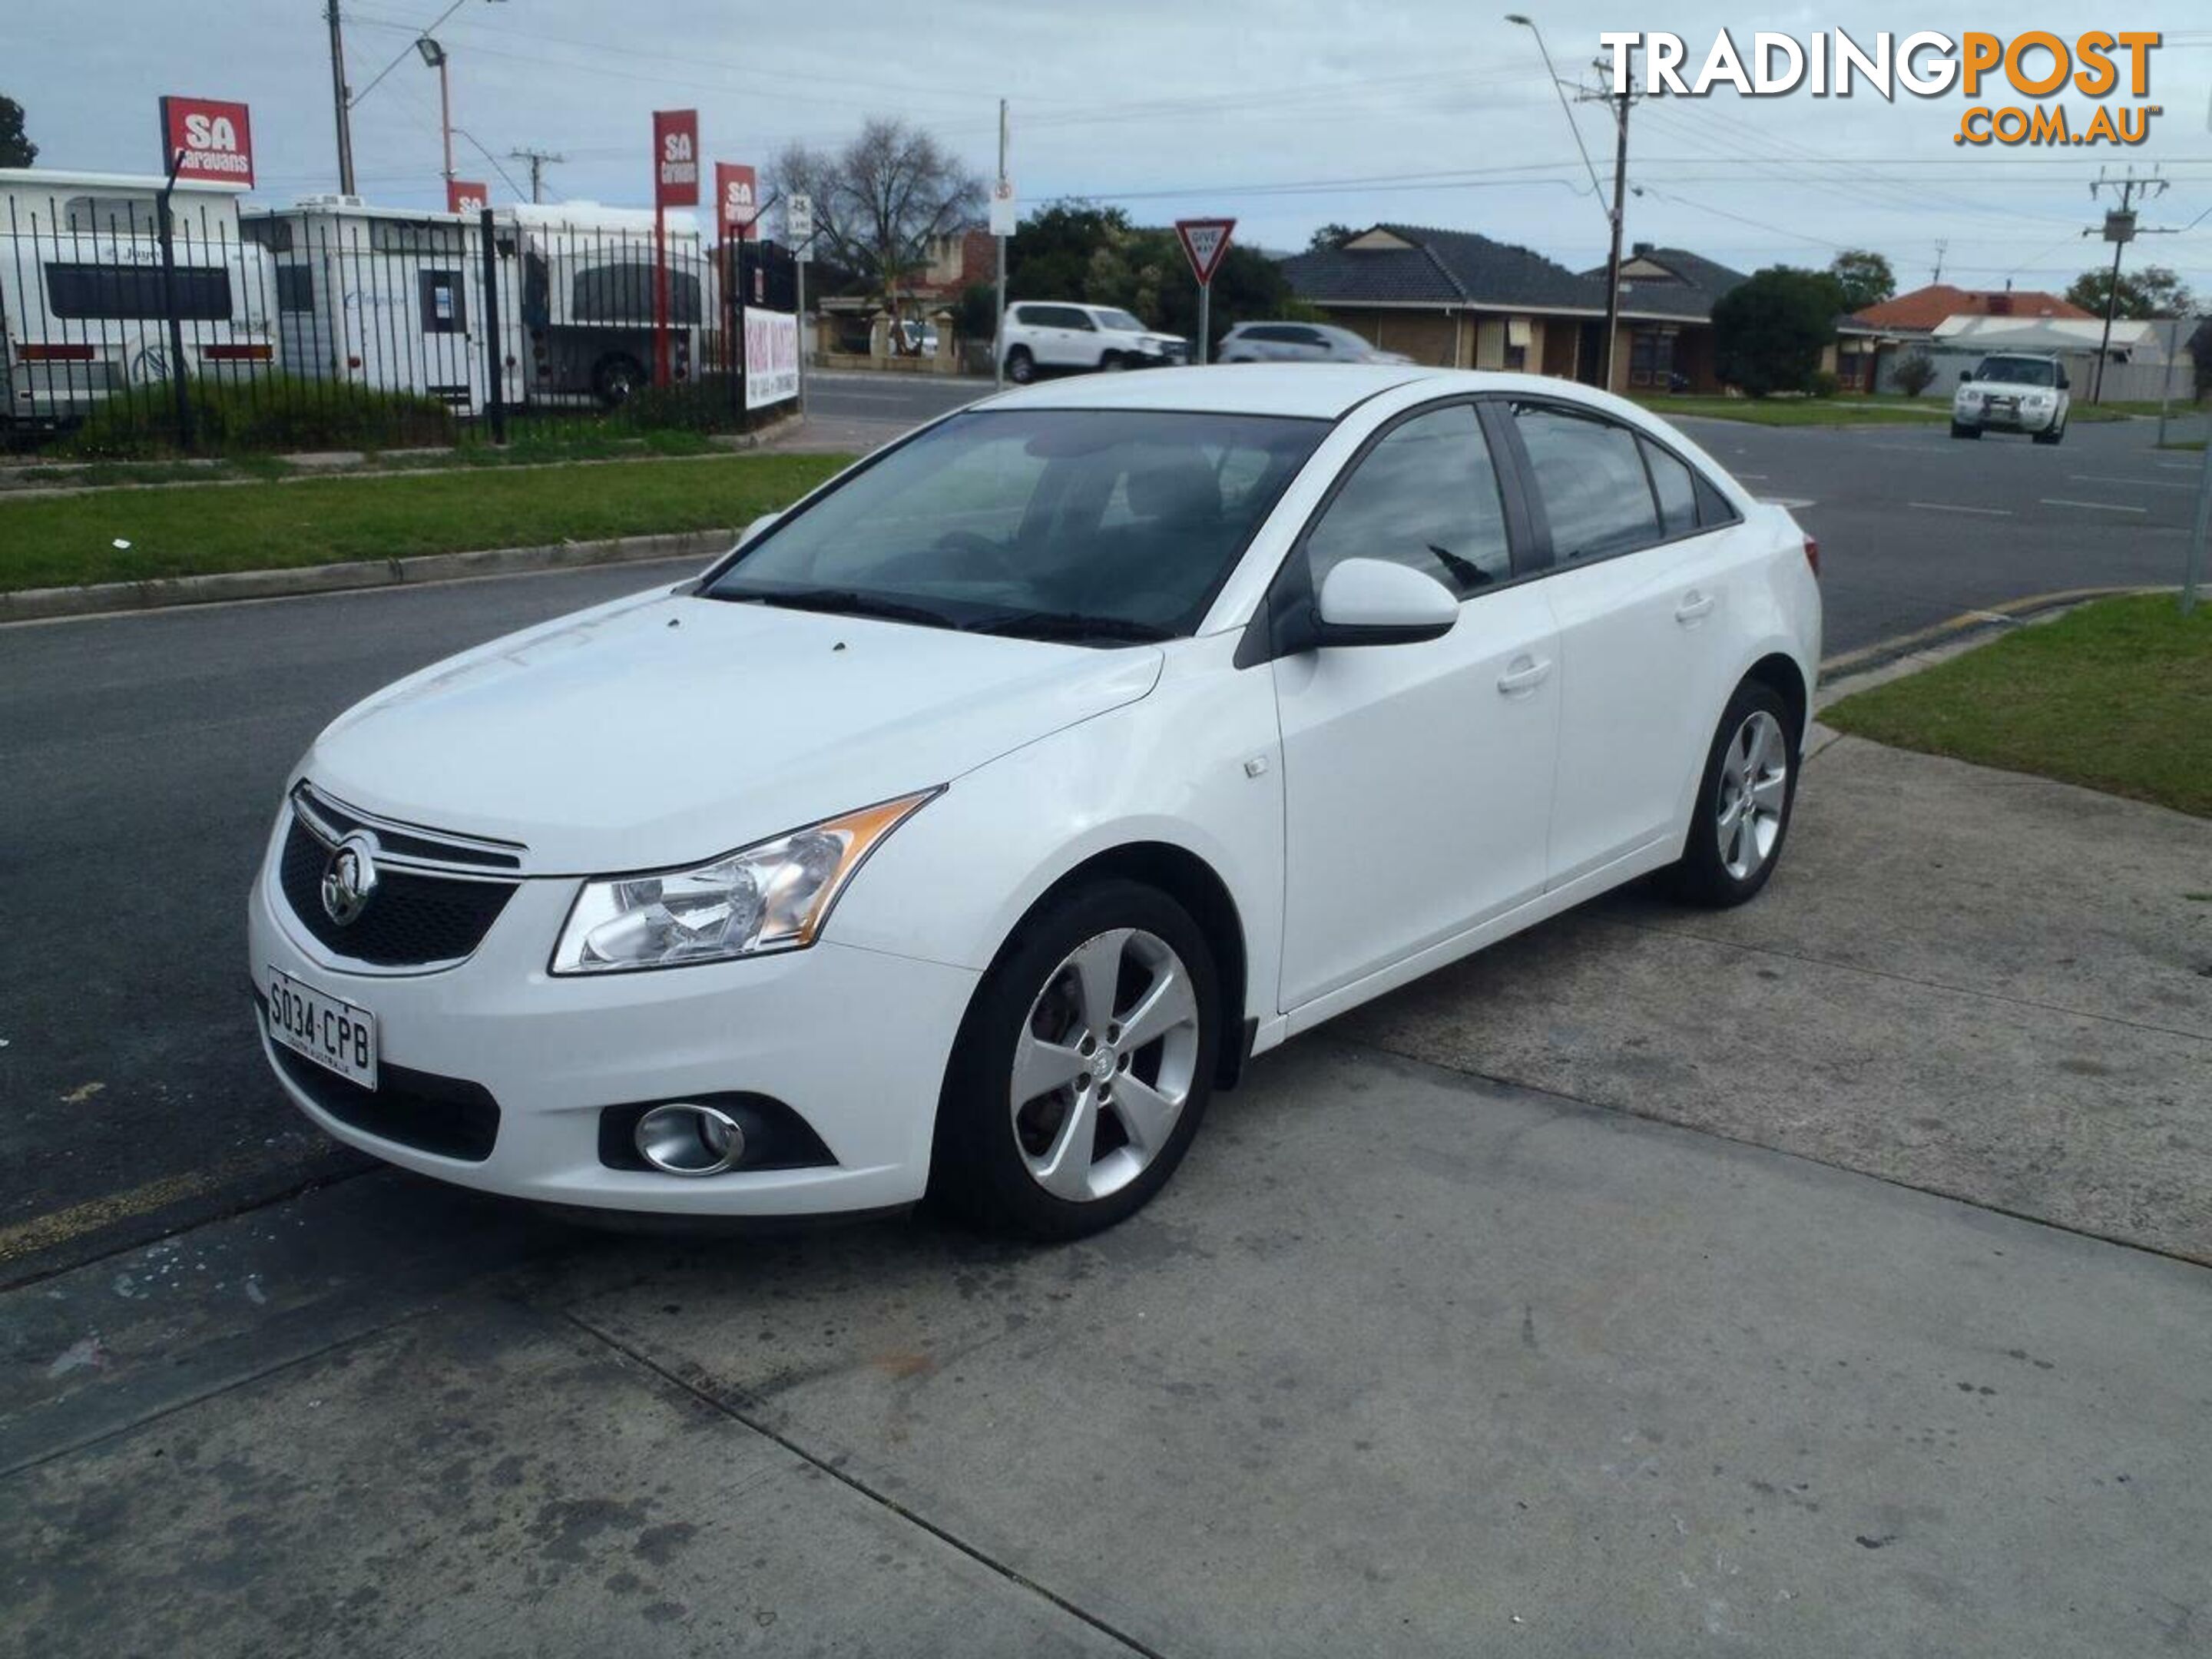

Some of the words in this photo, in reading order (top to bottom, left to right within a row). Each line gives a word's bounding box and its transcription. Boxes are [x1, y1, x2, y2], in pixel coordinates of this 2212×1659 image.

[185, 114, 236, 151] SA
[664, 133, 691, 161] SA
[728, 181, 752, 205] SA
[1192, 231, 1217, 242] GIVE
